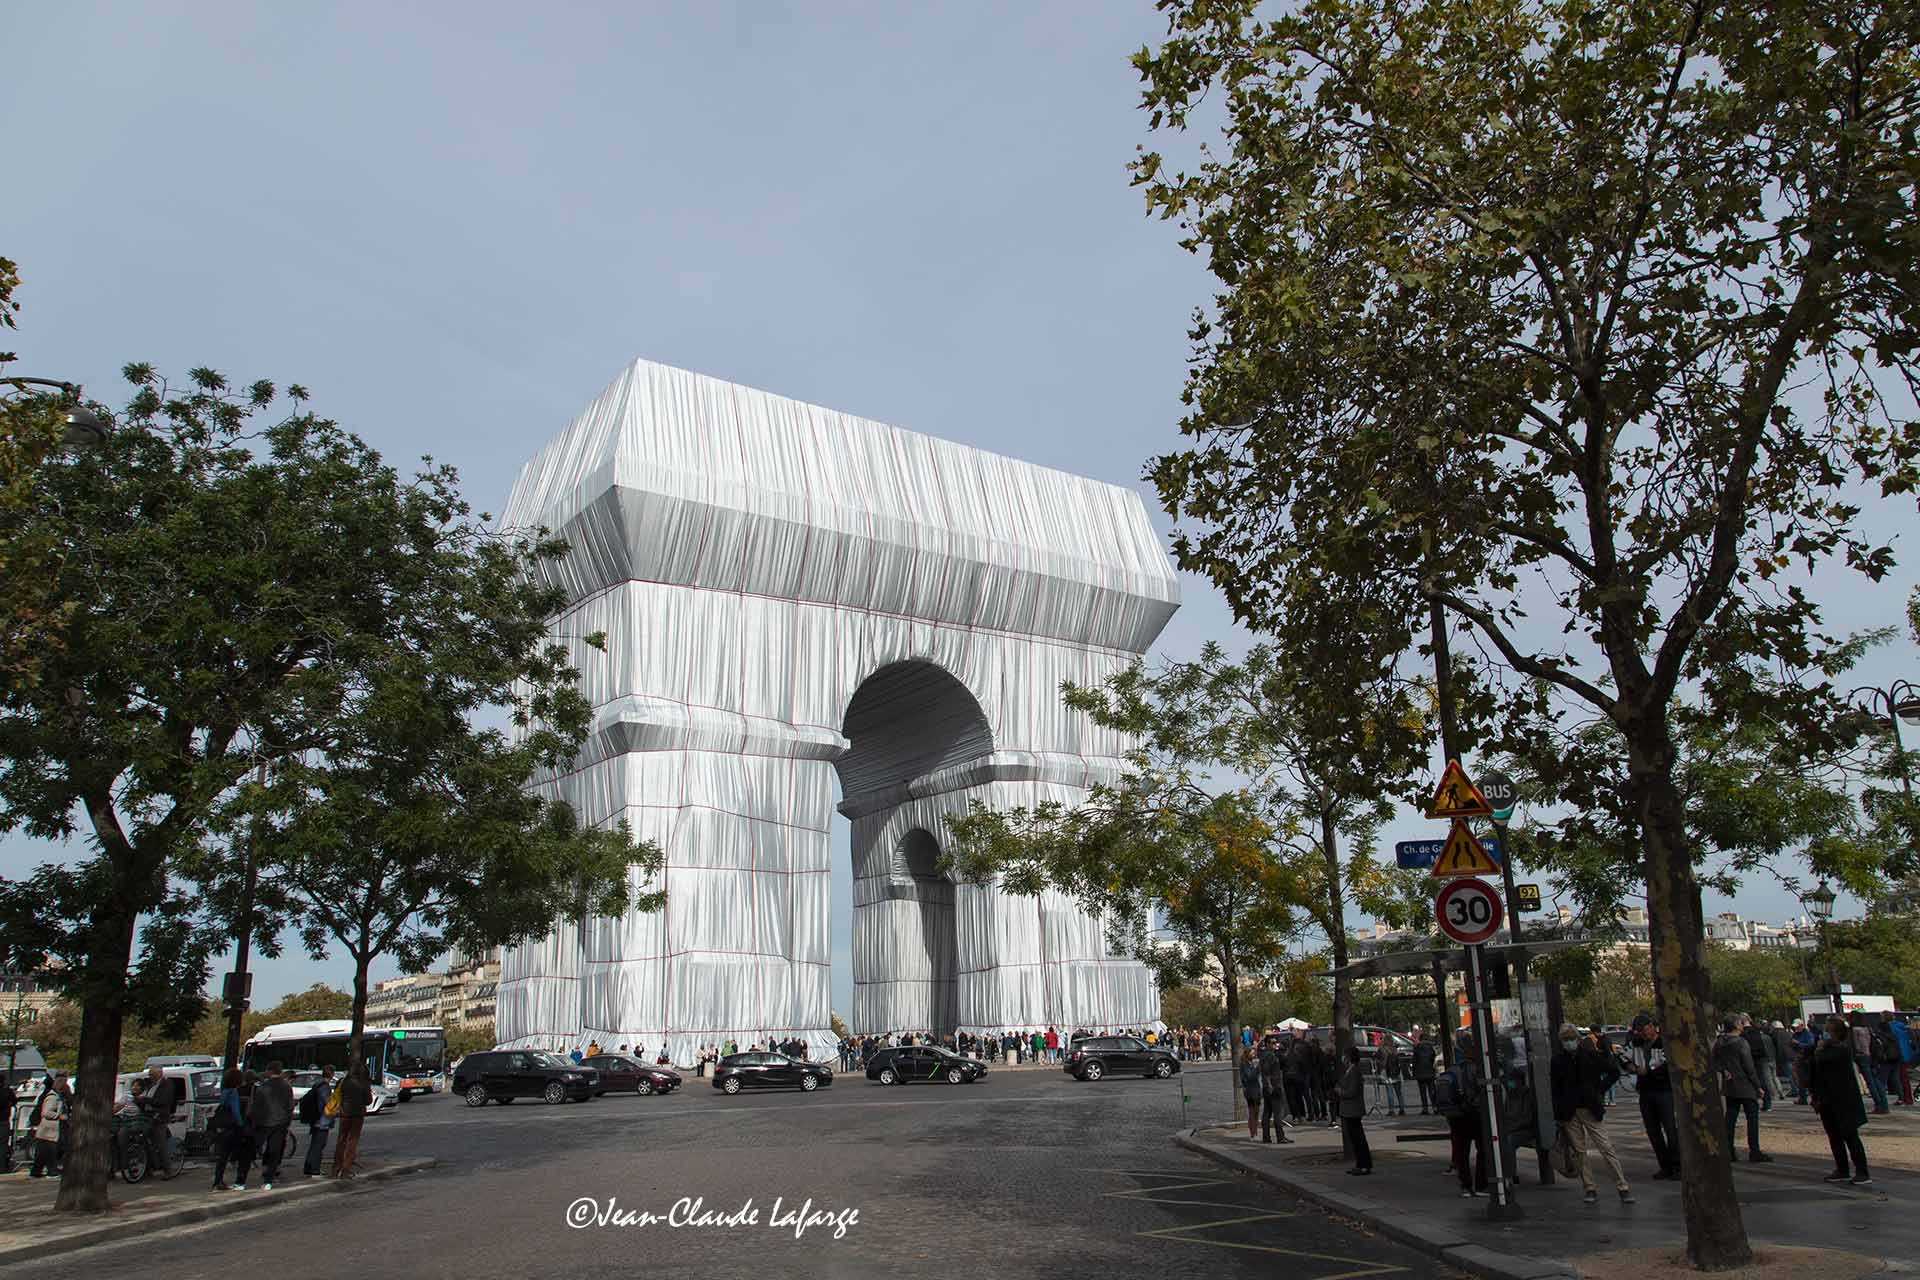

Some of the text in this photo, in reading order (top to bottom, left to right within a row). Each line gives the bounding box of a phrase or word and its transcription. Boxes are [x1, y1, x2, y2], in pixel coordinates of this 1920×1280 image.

[1483, 784, 1511, 799] BUS
[1403, 843, 1418, 855] Ch.
[1419, 844, 1430, 853] de
[1521, 888, 1536, 898] 92
[1448, 896, 1491, 926] 30
